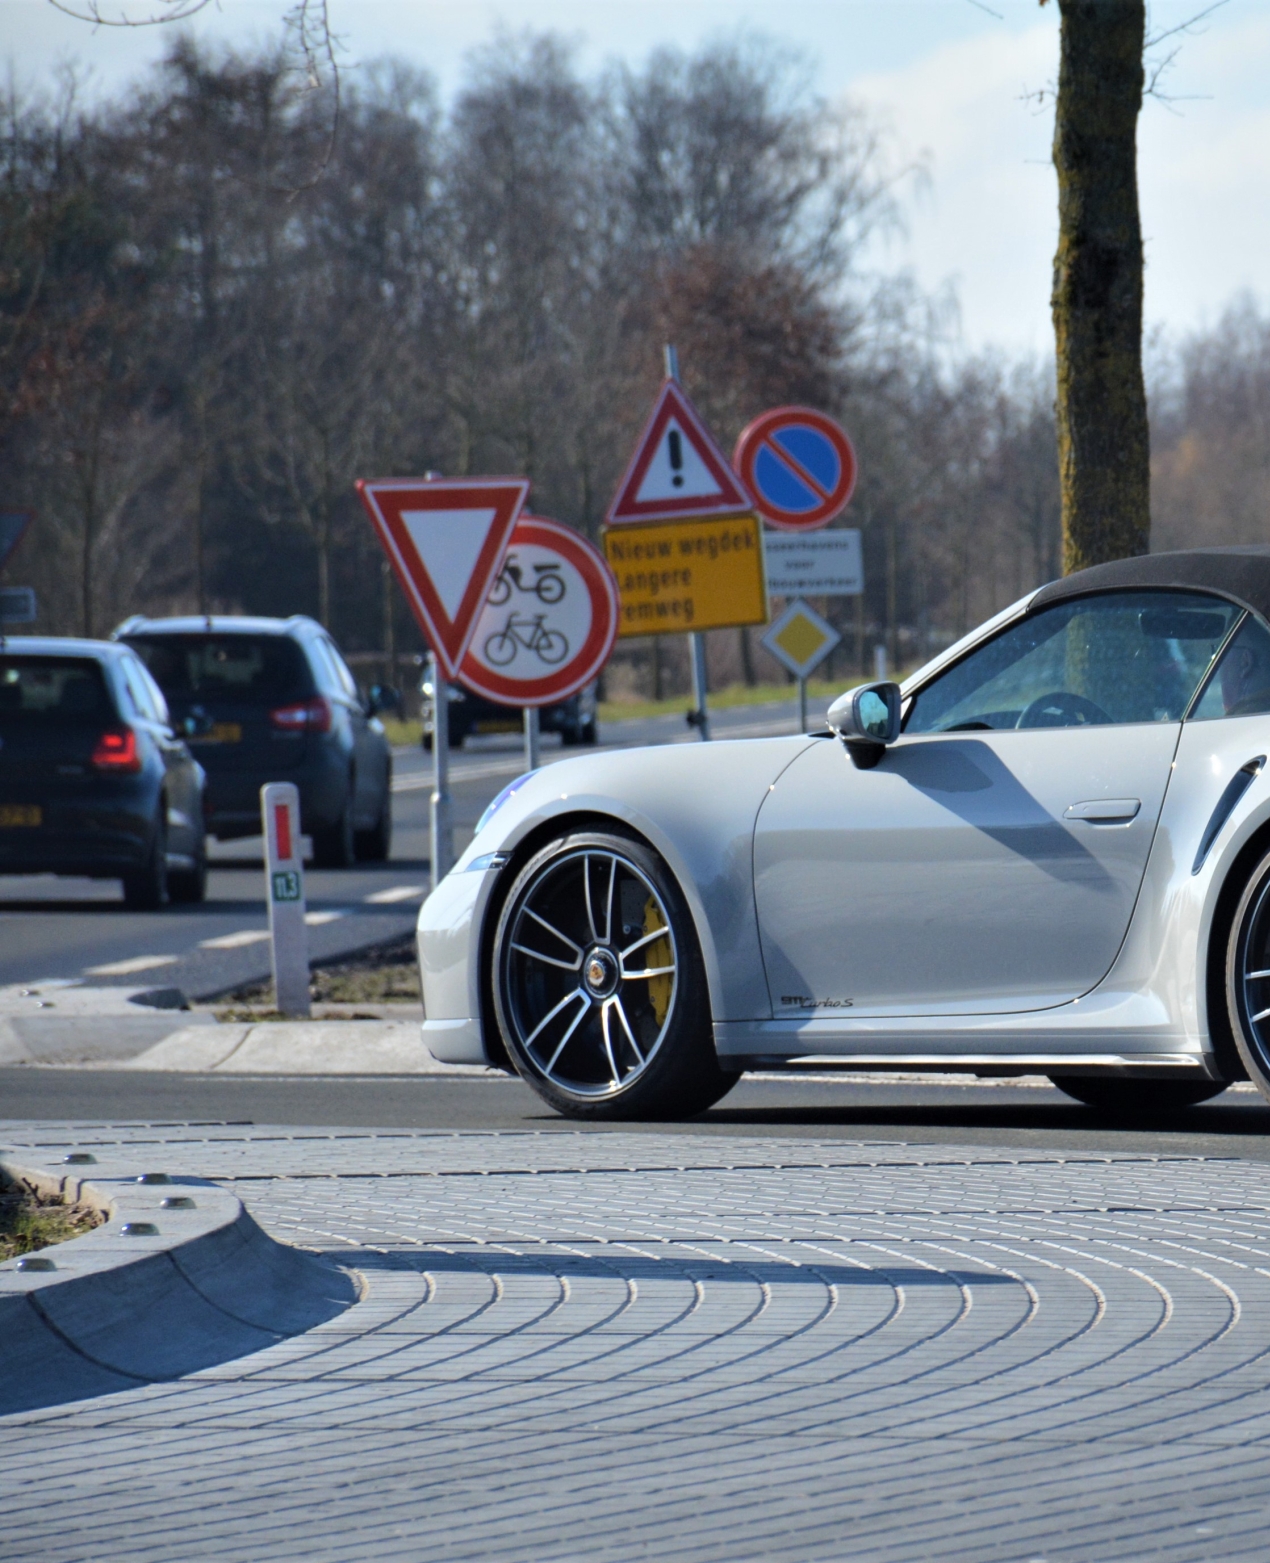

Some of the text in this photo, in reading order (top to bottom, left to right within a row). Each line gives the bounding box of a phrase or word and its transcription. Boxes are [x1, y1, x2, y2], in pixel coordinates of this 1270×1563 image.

[611, 529, 753, 560] Nieuw wegdek
[840, 998, 854, 1008] S
